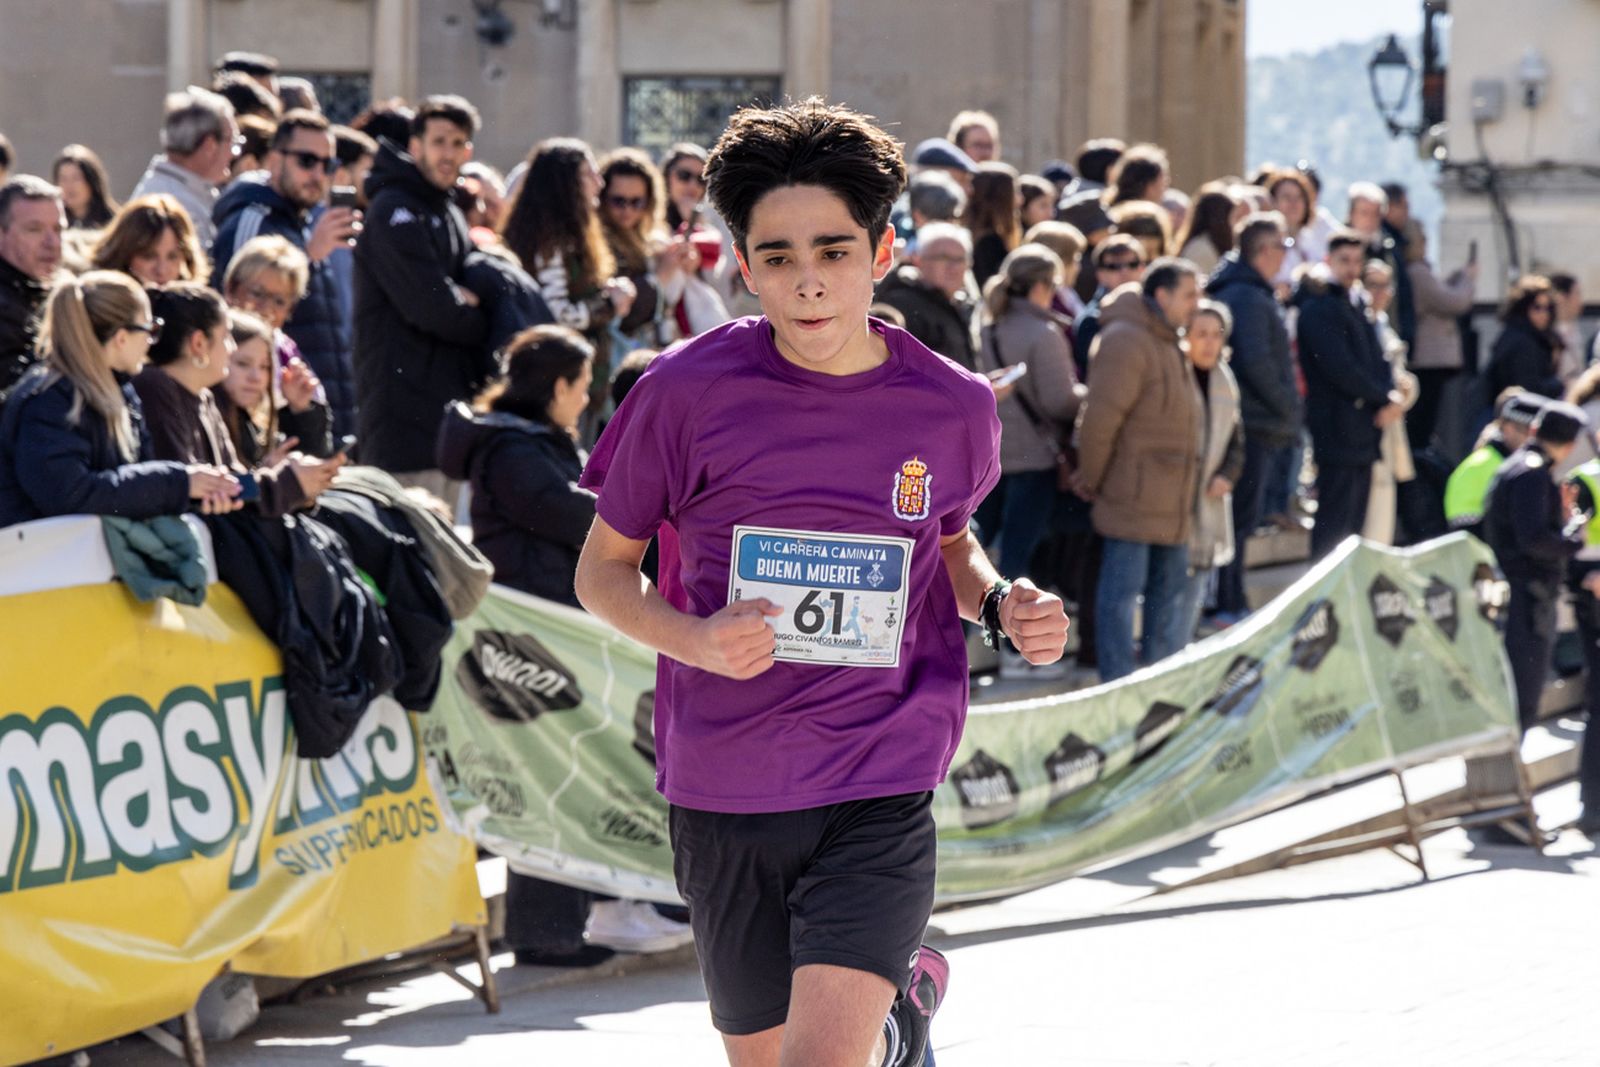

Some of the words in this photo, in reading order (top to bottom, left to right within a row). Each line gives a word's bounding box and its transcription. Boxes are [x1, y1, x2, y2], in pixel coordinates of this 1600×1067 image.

[759, 541, 770, 553] VI
[773, 543, 828, 558] CARRERA
[831, 548, 887, 561] CAMINATA
[756, 558, 802, 580] BUENA
[806, 563, 861, 585] MUERTE
[793, 590, 845, 635] 61
